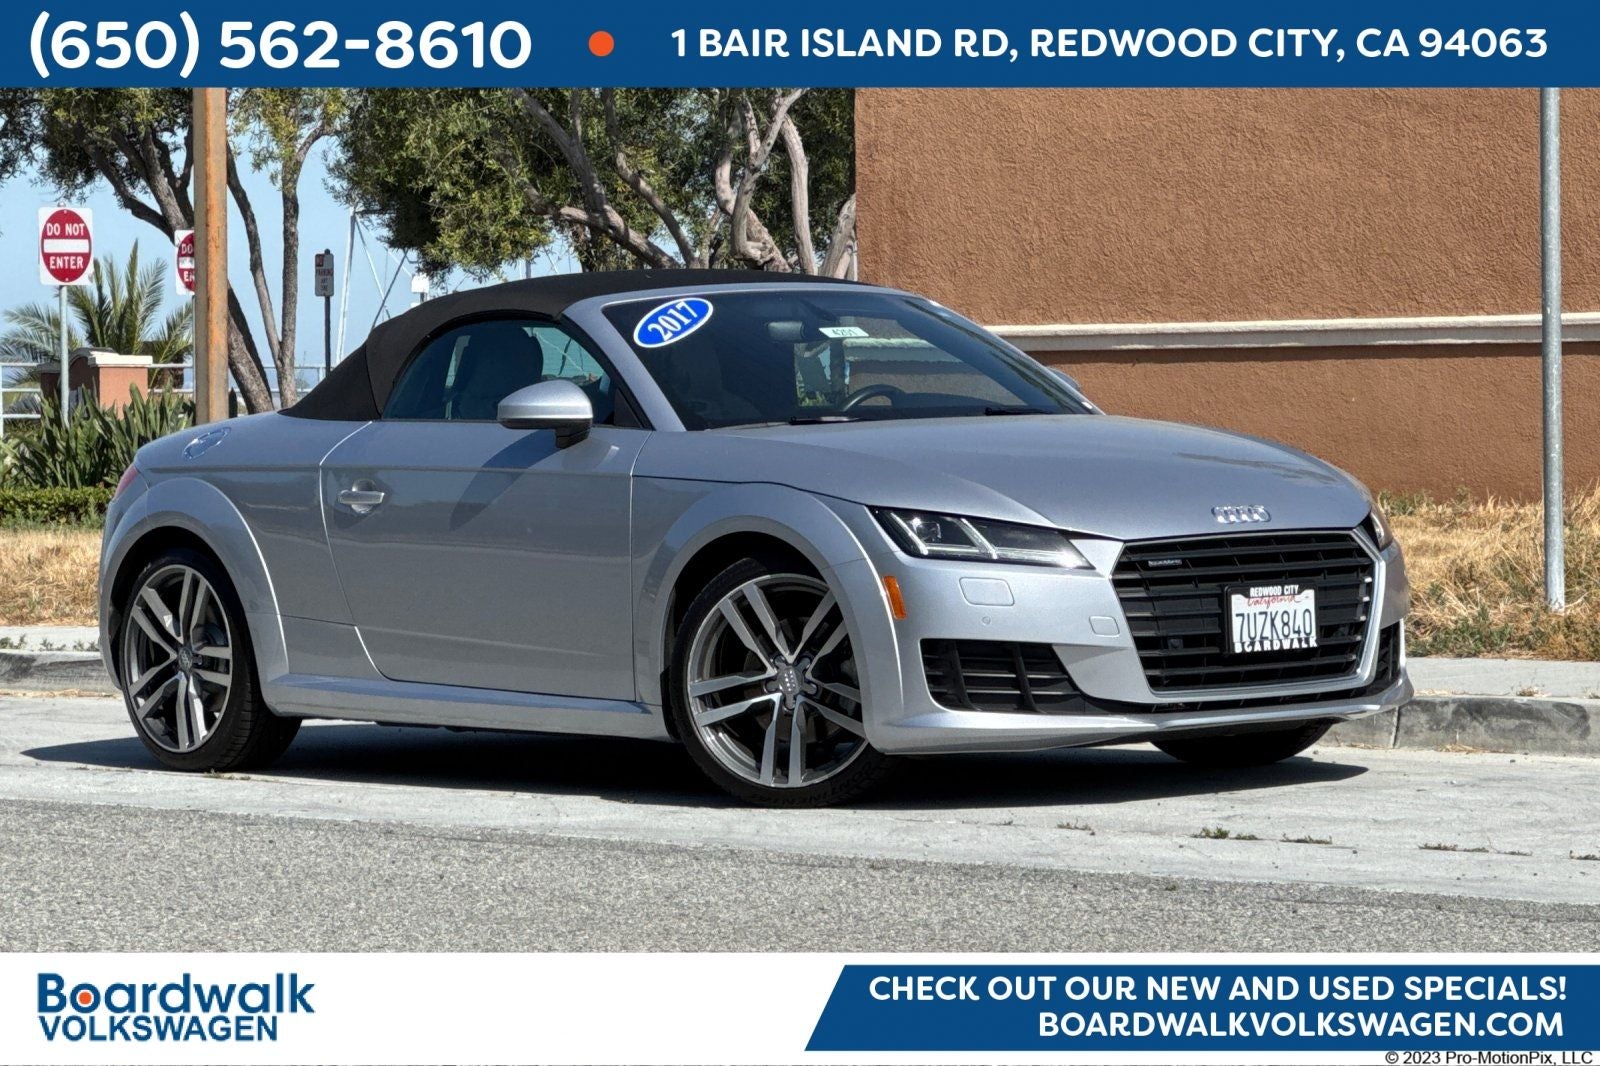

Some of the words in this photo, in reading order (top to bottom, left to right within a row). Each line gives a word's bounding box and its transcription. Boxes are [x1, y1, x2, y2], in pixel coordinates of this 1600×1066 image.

[47, 223, 61, 236] DO
[66, 223, 85, 236] NOT
[181, 243, 193, 254] DO
[49, 256, 84, 269] ENTER
[648, 301, 698, 341] 2017
[1250, 586, 1282, 597] REDWOOD
[1284, 585, 1299, 594] CITY
[1235, 608, 1312, 641] 7UZK840
